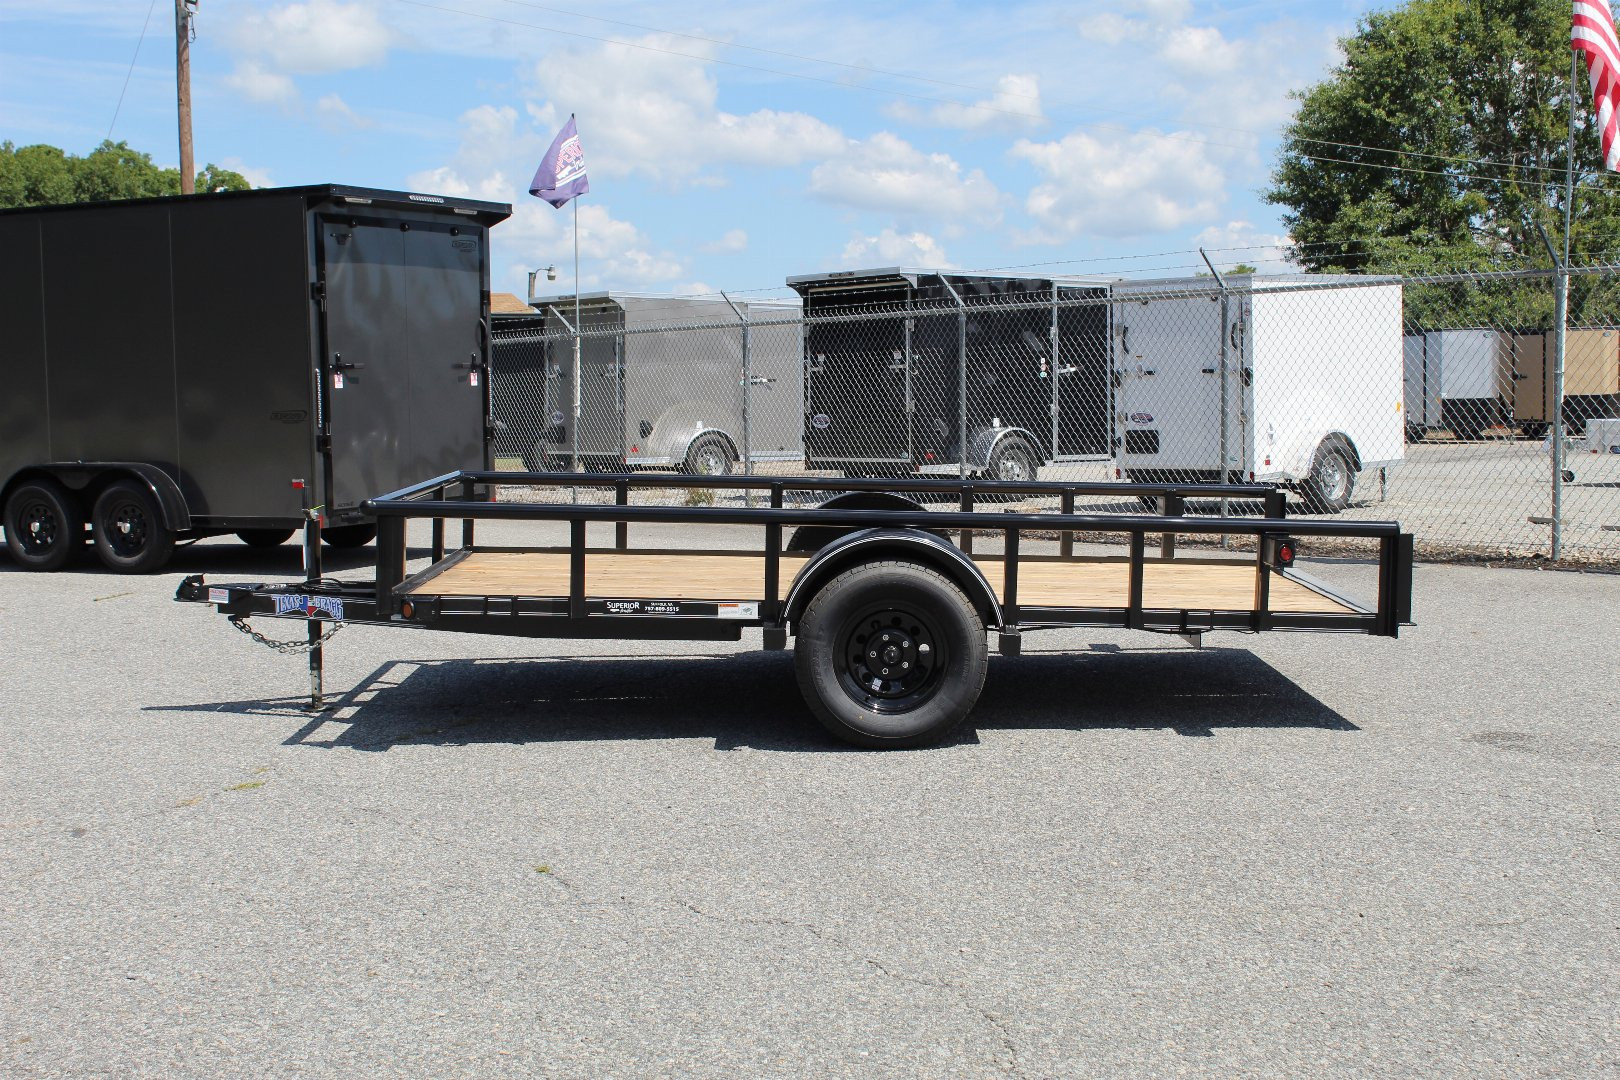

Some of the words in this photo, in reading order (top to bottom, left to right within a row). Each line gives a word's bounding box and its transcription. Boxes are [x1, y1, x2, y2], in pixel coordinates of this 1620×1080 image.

[271, 595, 300, 615] TEXAS
[314, 596, 343, 621] BRAGG
[606, 601, 640, 609] SUPERIOR
